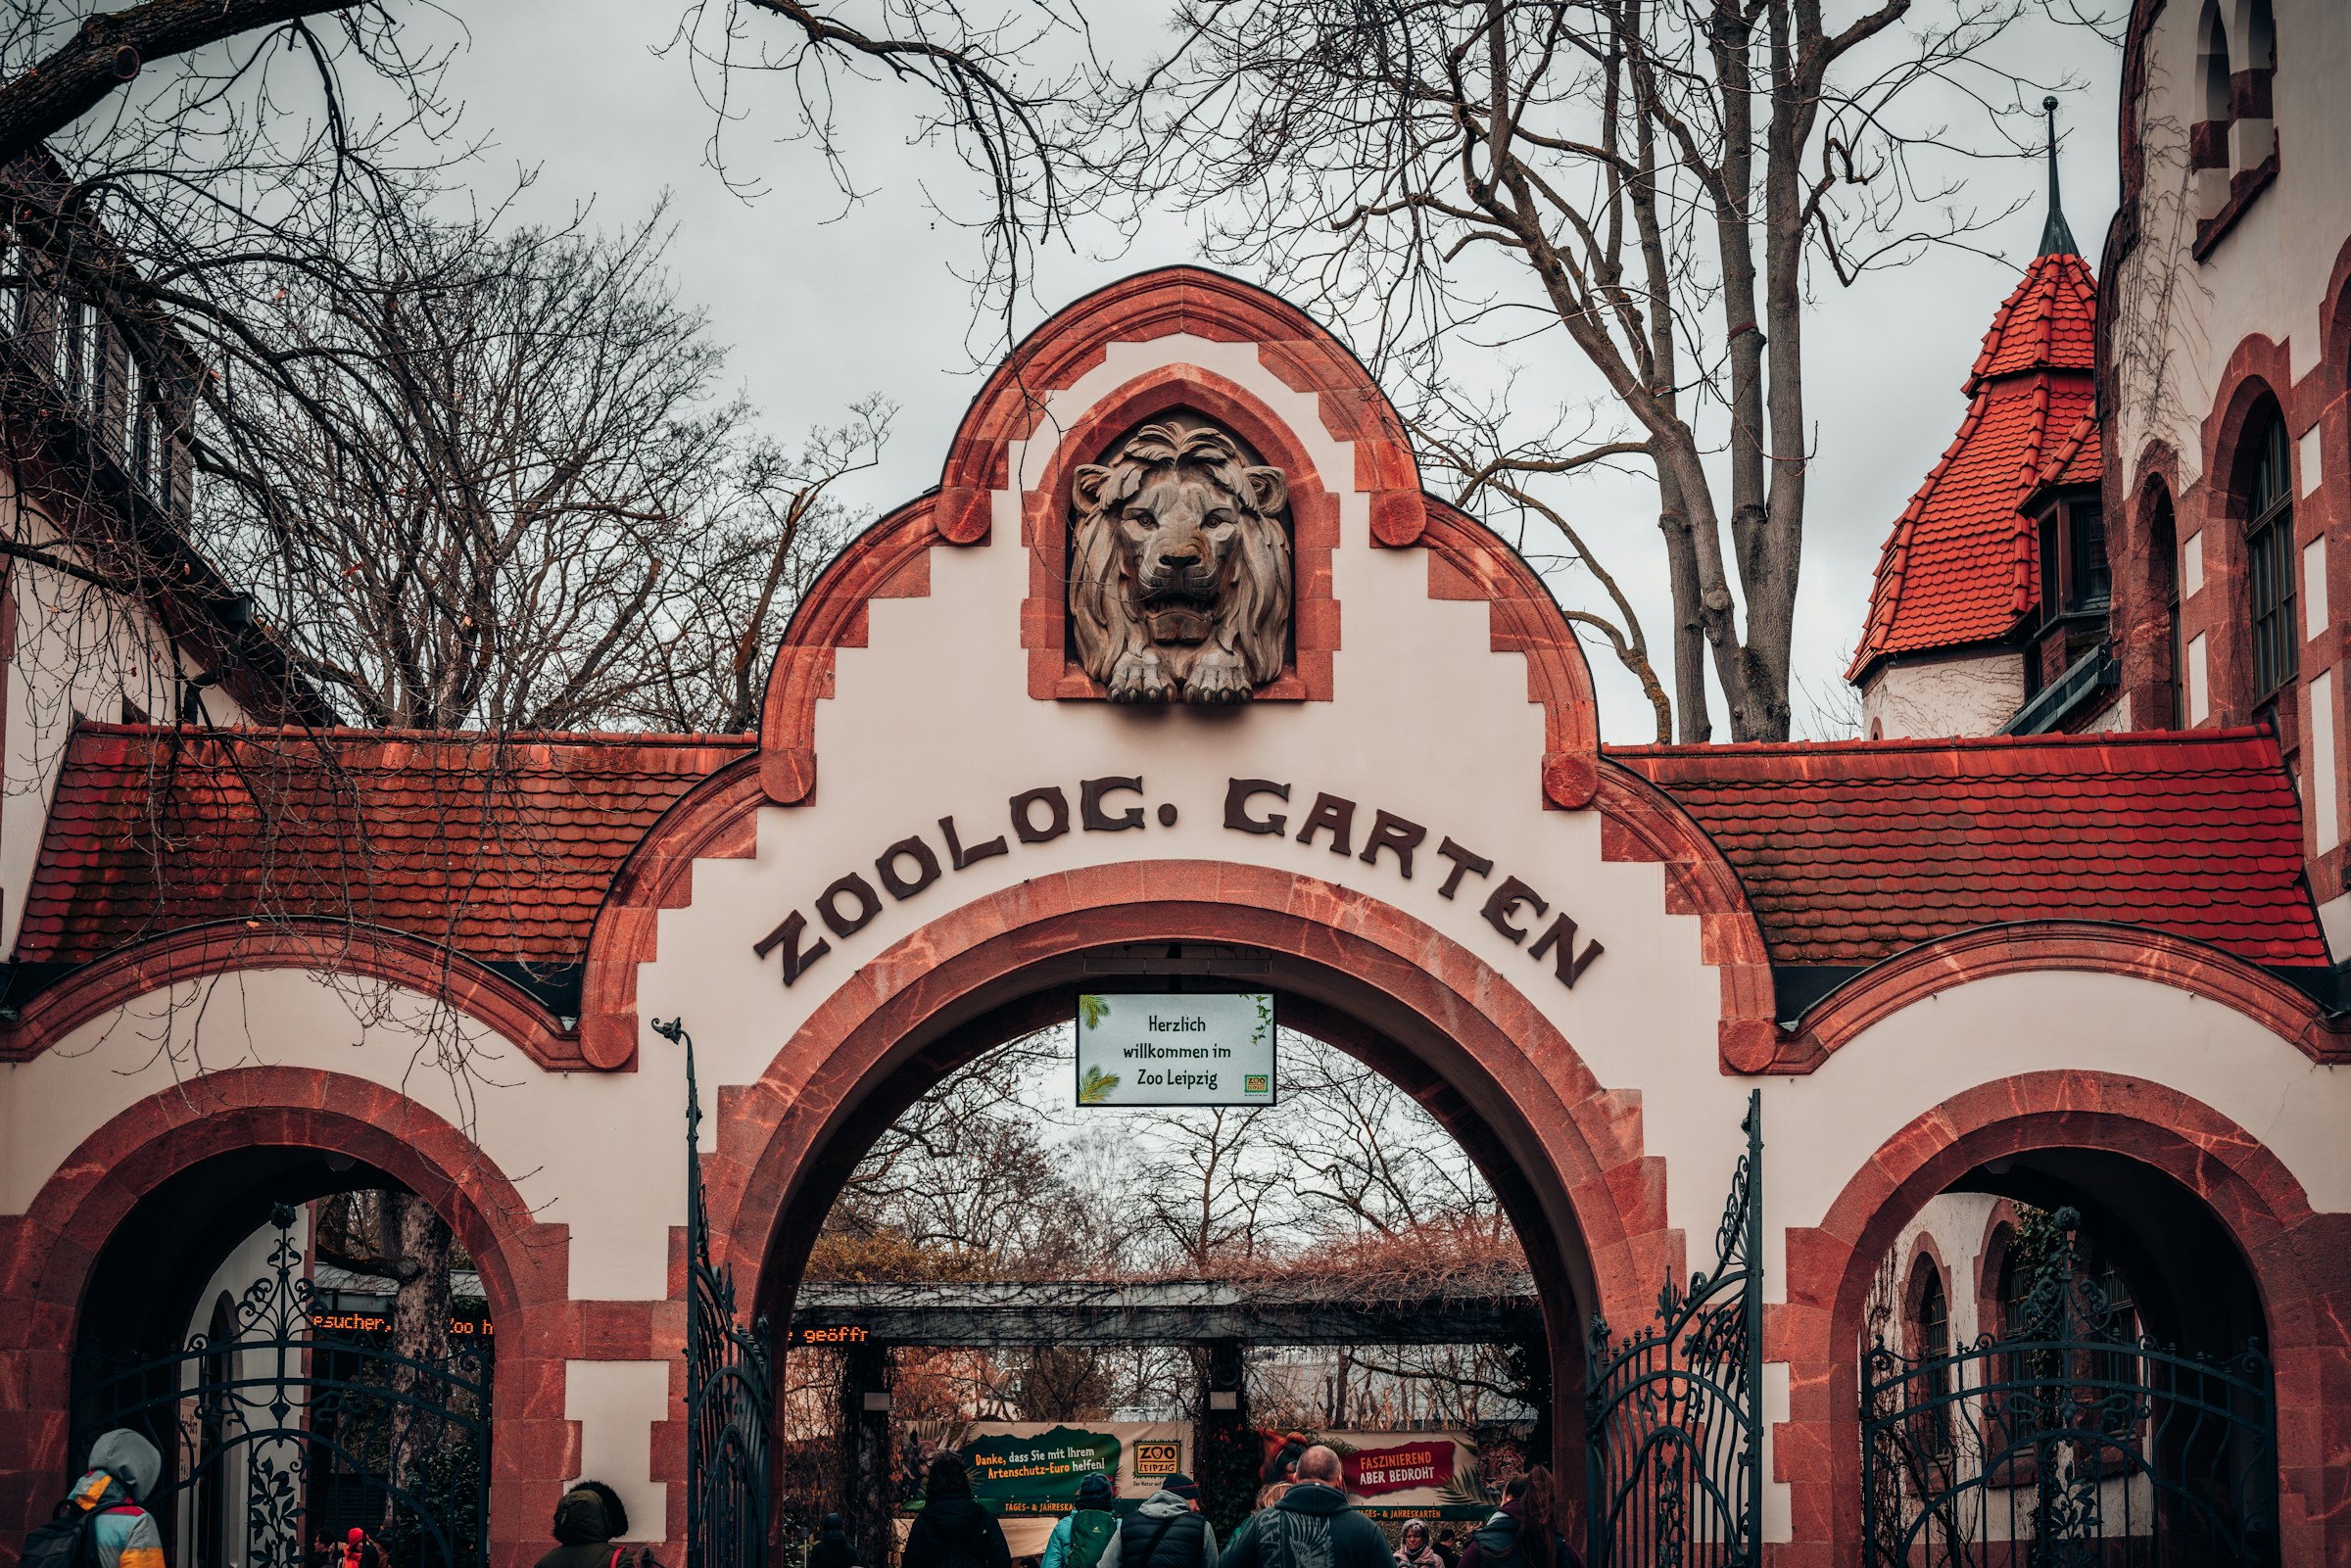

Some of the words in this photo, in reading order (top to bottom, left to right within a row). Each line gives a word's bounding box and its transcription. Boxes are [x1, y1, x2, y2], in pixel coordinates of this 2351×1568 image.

[753, 775, 1177, 987] ZOOLOG.
[1223, 777, 1607, 989] GARTEN
[1148, 1015, 1206, 1032] Herzlich
[1124, 1043, 1209, 1059] willkommen
[1213, 1043, 1231, 1059] im
[1137, 1069, 1163, 1085] Zoo
[1168, 1069, 1218, 1090] Leipzig
[975, 1453, 1007, 1466] Danke,
[1008, 1451, 1029, 1463] dass
[1031, 1449, 1045, 1461] Sie
[1047, 1448, 1065, 1460] mit
[1067, 1447, 1095, 1458] Ihrem
[1139, 1447, 1176, 1459] ZOO
[1360, 1451, 1431, 1470] FASZINIEREND
[987, 1462, 1070, 1480] Artenschutz-Euro
[1072, 1457, 1105, 1472] helfen!
[1139, 1463, 1176, 1472] LEIPZIG
[1360, 1470, 1386, 1485] ABER
[1389, 1466, 1434, 1483] BEDROHT
[1005, 1503, 1030, 1512] TAGES-
[1039, 1502, 1076, 1512] JAHRESKA
[1382, 1509, 1388, 1518] &
[1390, 1509, 1441, 1519] JAHRESKARTEN
